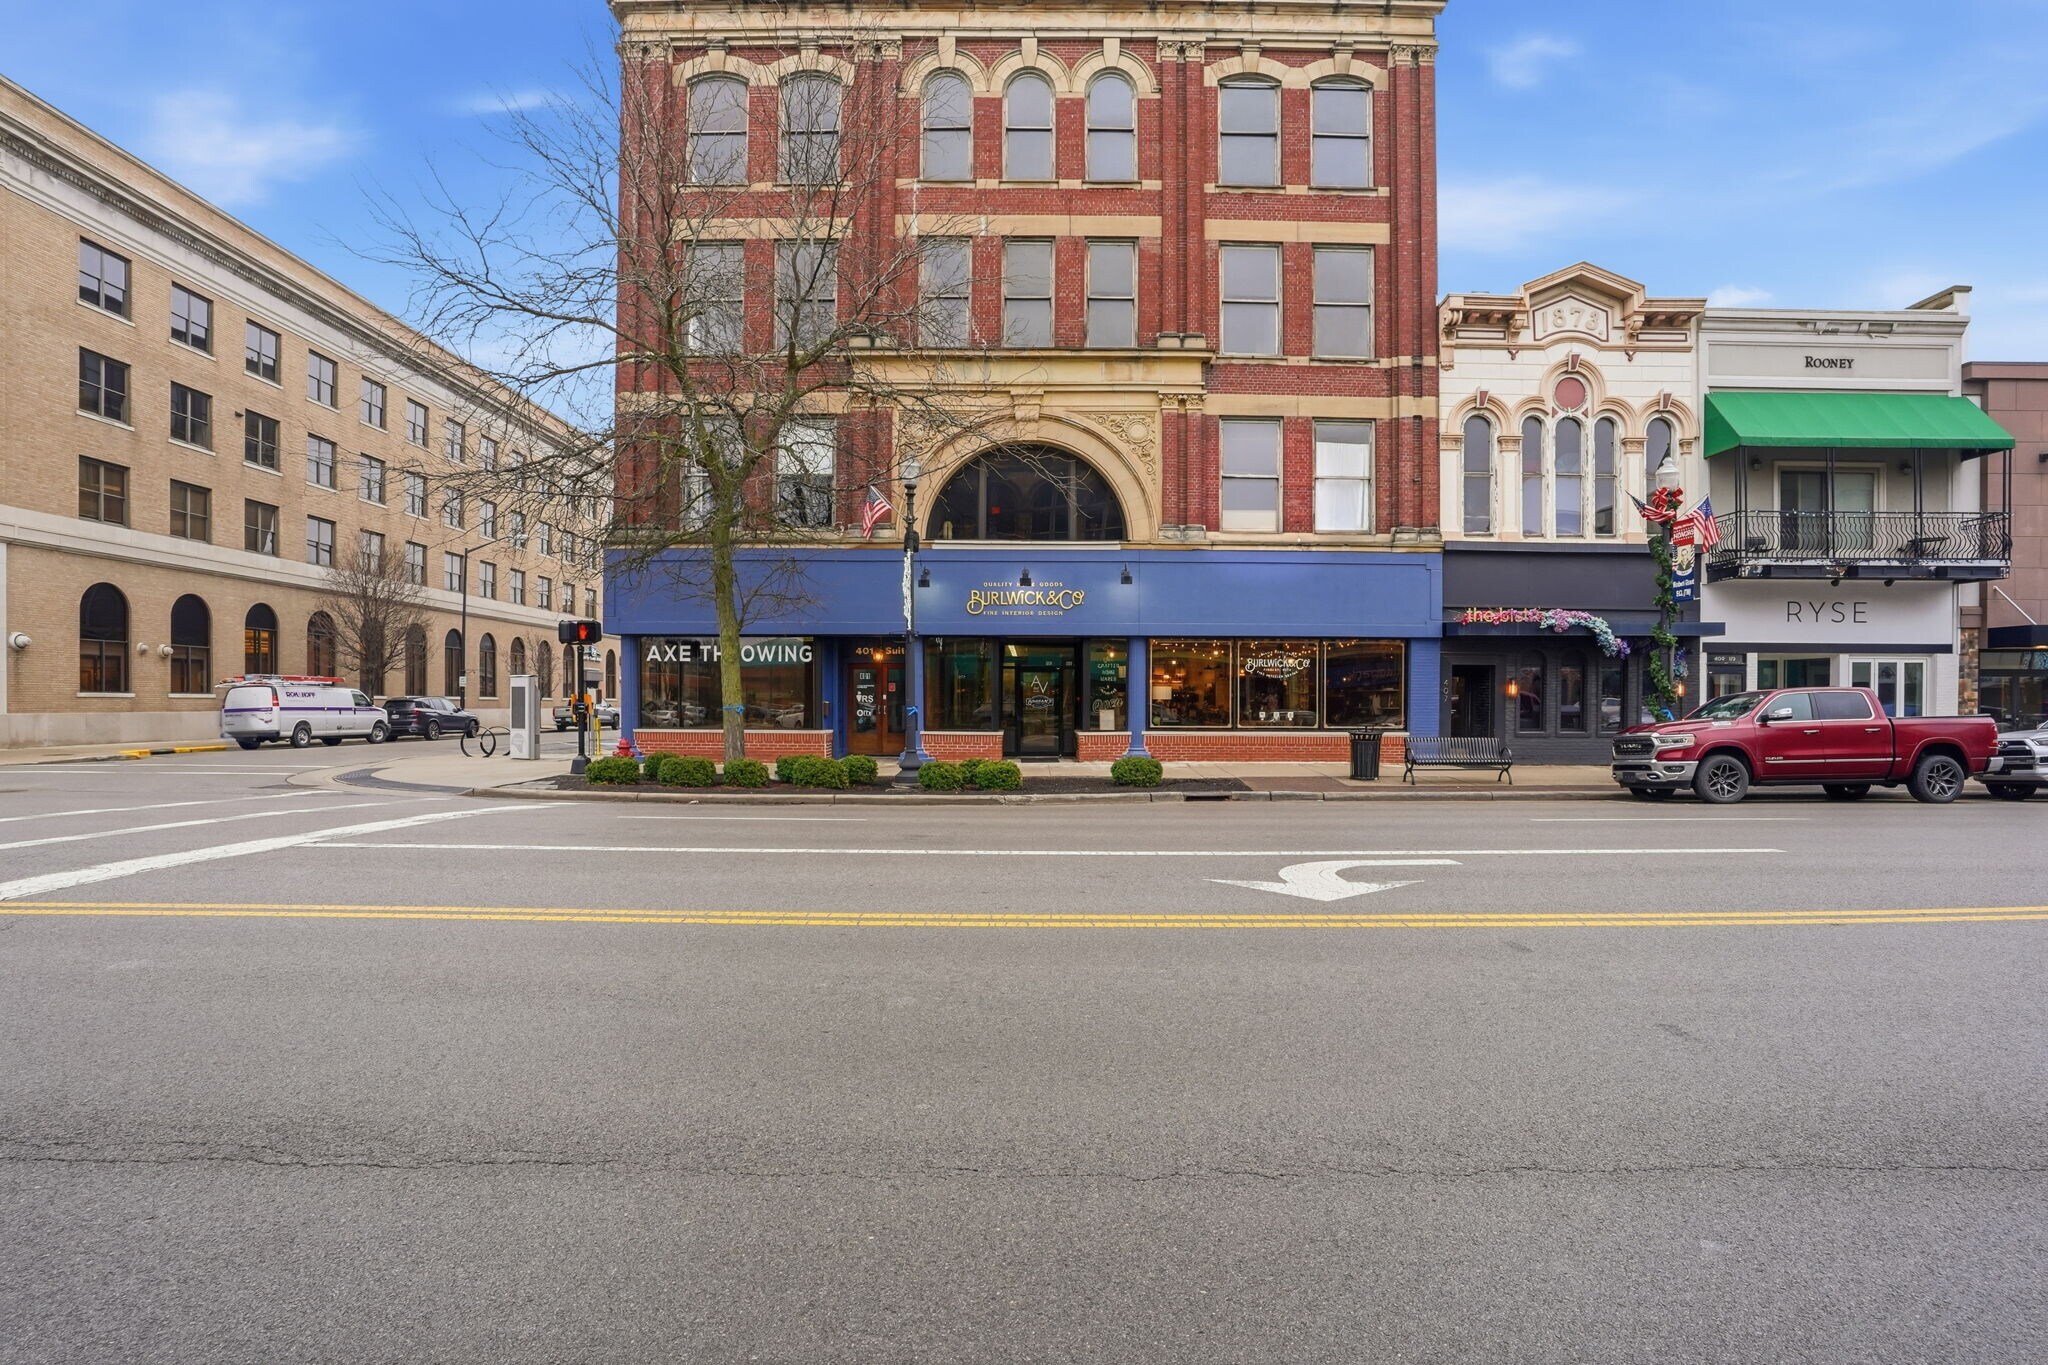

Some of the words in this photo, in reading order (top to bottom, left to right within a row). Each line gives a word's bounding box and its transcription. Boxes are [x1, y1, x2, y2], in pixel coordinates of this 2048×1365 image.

[1467, 607, 1495, 622] the
[1787, 601, 1868, 623] RYSE
[646, 645, 692, 662] AXE
[700, 645, 813, 662] THOWING
[856, 647, 874, 655] 401
[885, 646, 906, 655] Suit
